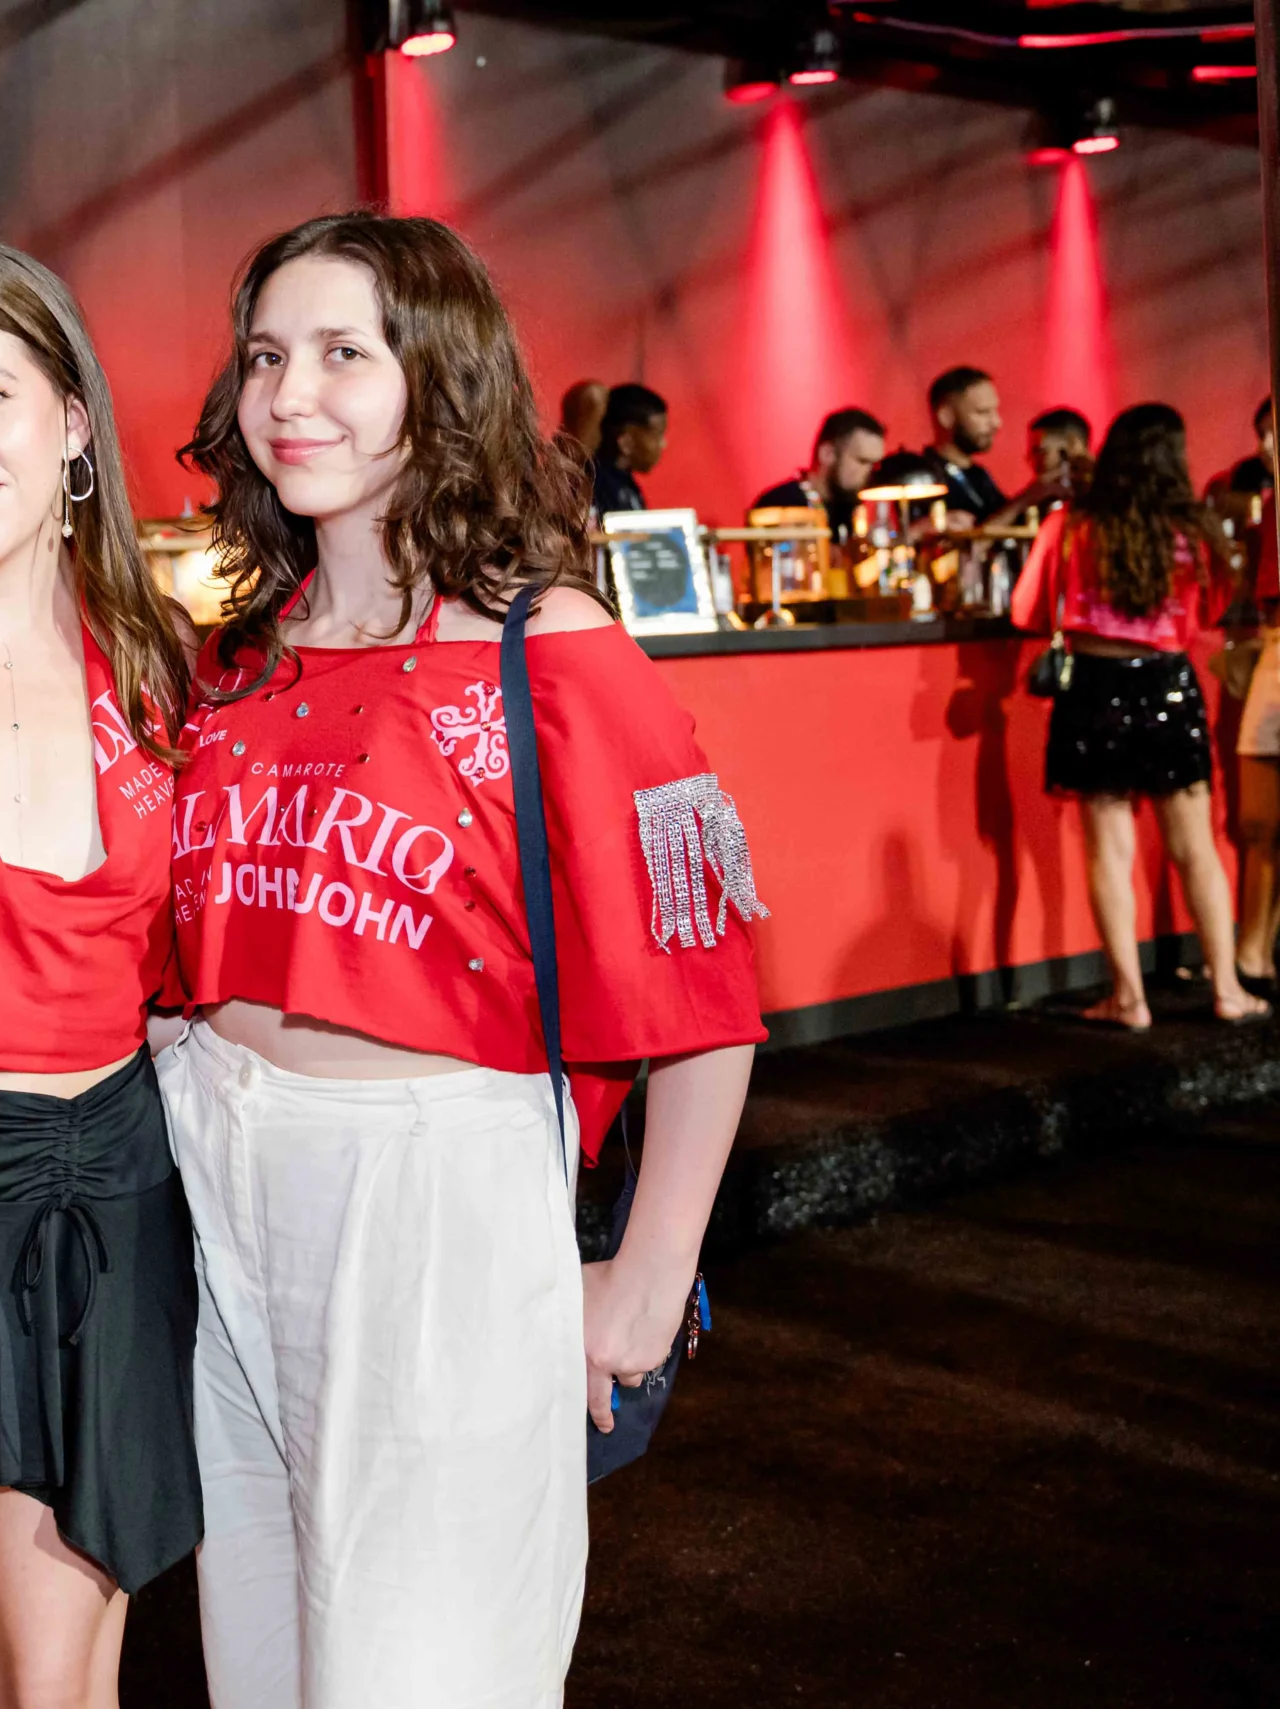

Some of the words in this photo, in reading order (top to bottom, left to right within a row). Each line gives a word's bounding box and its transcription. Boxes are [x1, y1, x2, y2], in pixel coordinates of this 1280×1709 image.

[199, 729, 228, 748] LOVE
[119, 762, 164, 801] MADE
[251, 761, 346, 778] CAMAROTE
[133, 775, 174, 819] HEAVE
[294, 872, 434, 950] JOHN
